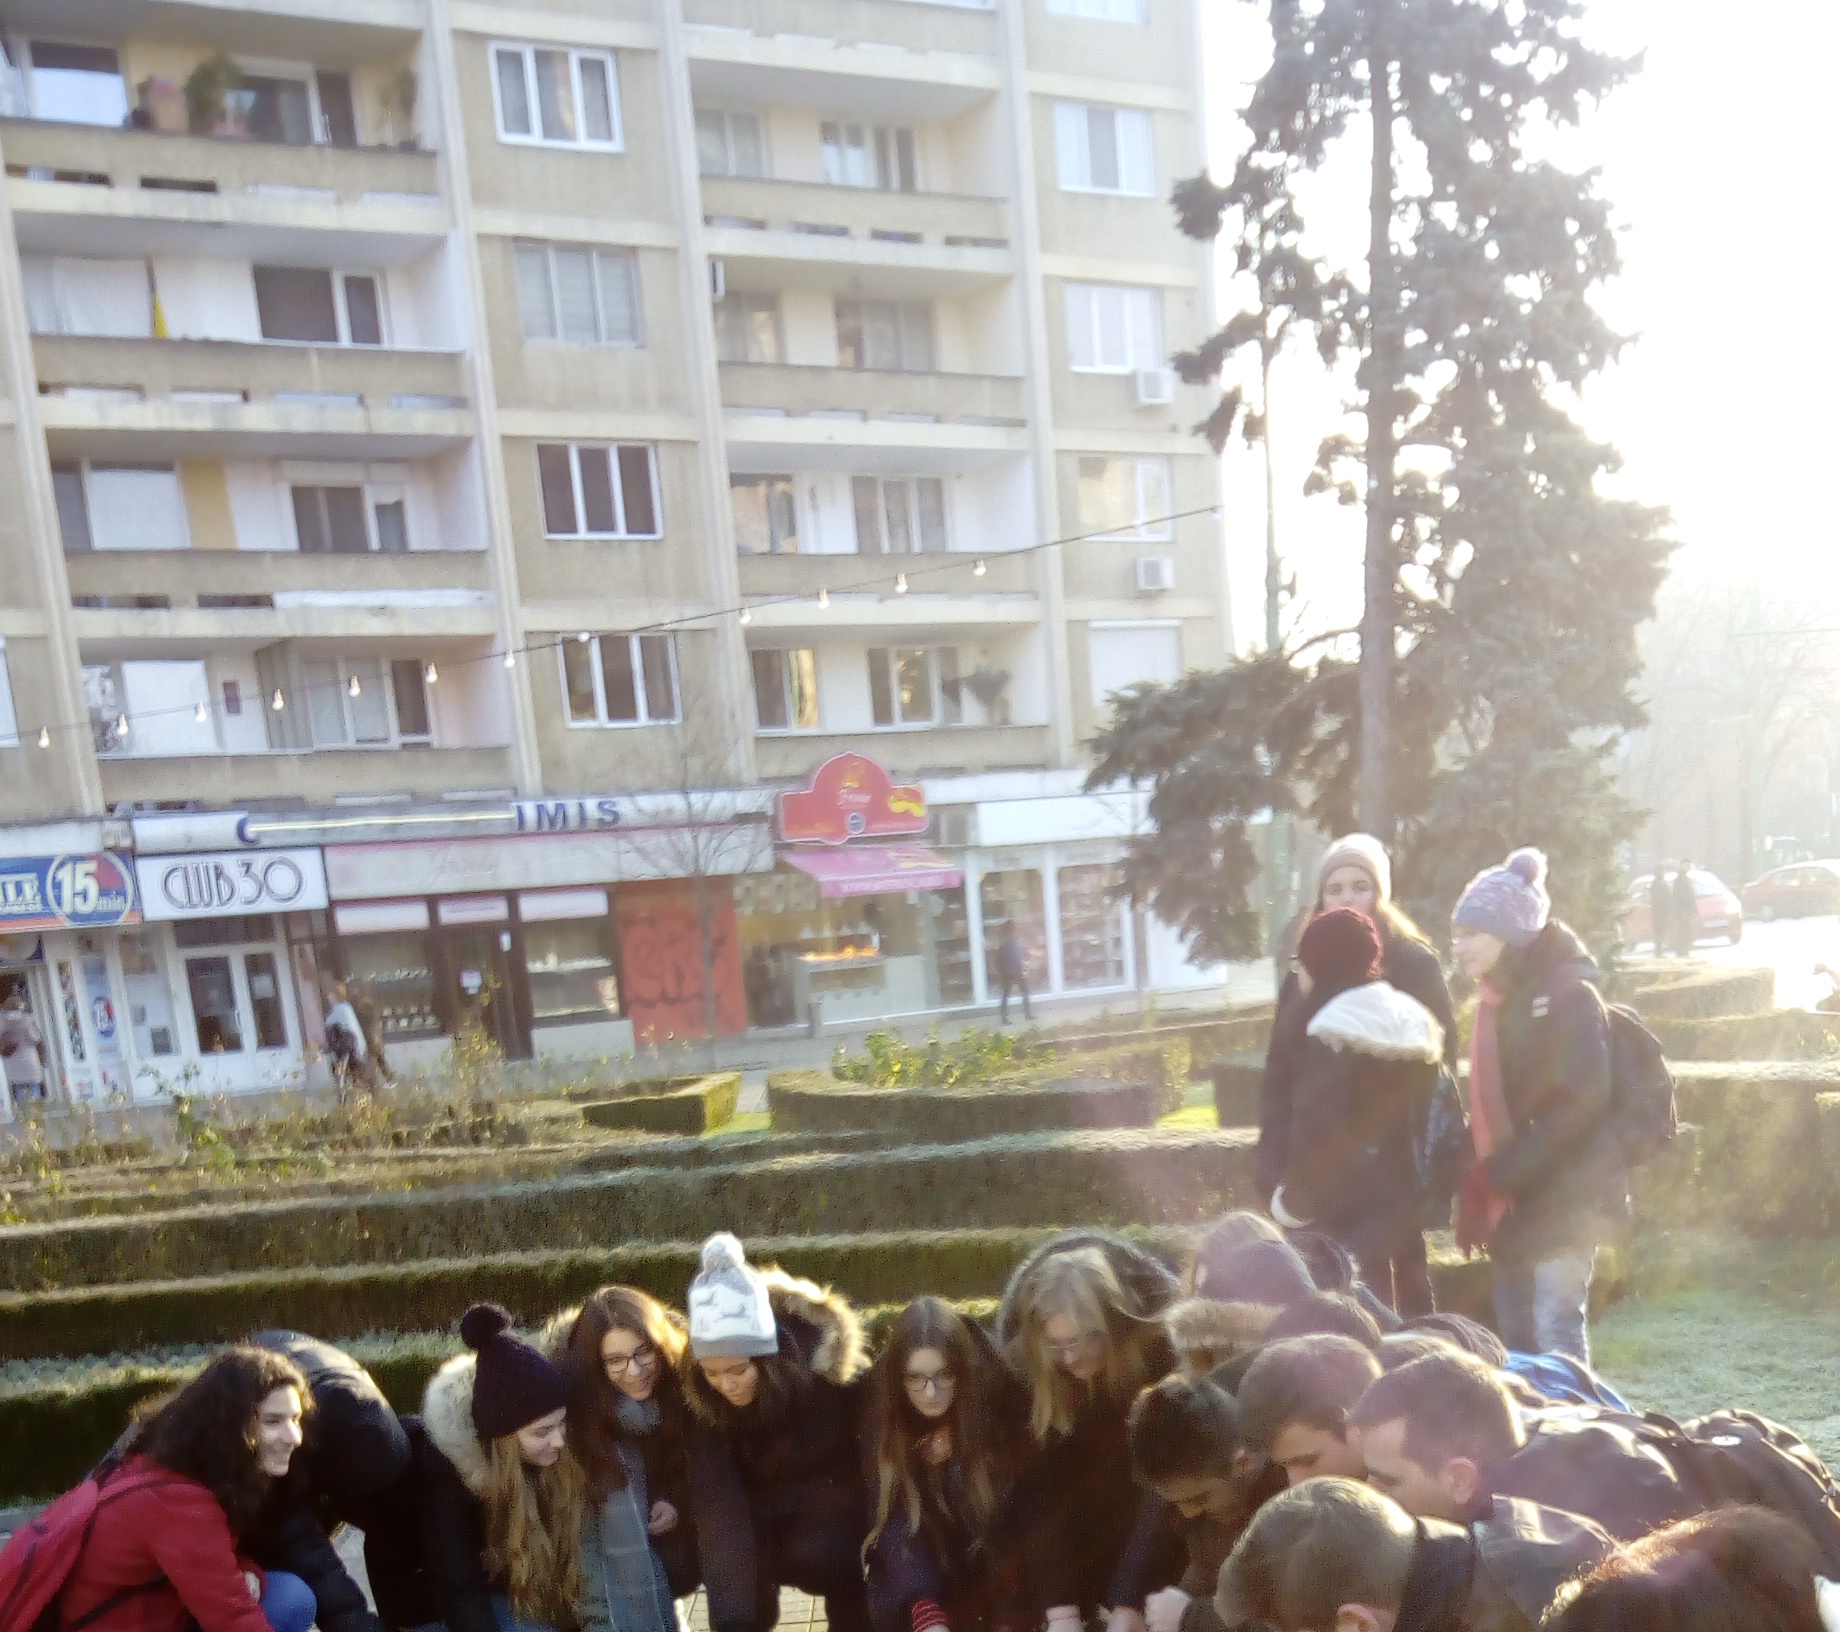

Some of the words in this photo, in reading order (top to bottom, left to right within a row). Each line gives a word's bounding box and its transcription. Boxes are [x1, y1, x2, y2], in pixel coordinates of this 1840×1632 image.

[54, 859, 100, 914] 15
[162, 861, 235, 909] CLUB
[236, 856, 305, 905] 30
